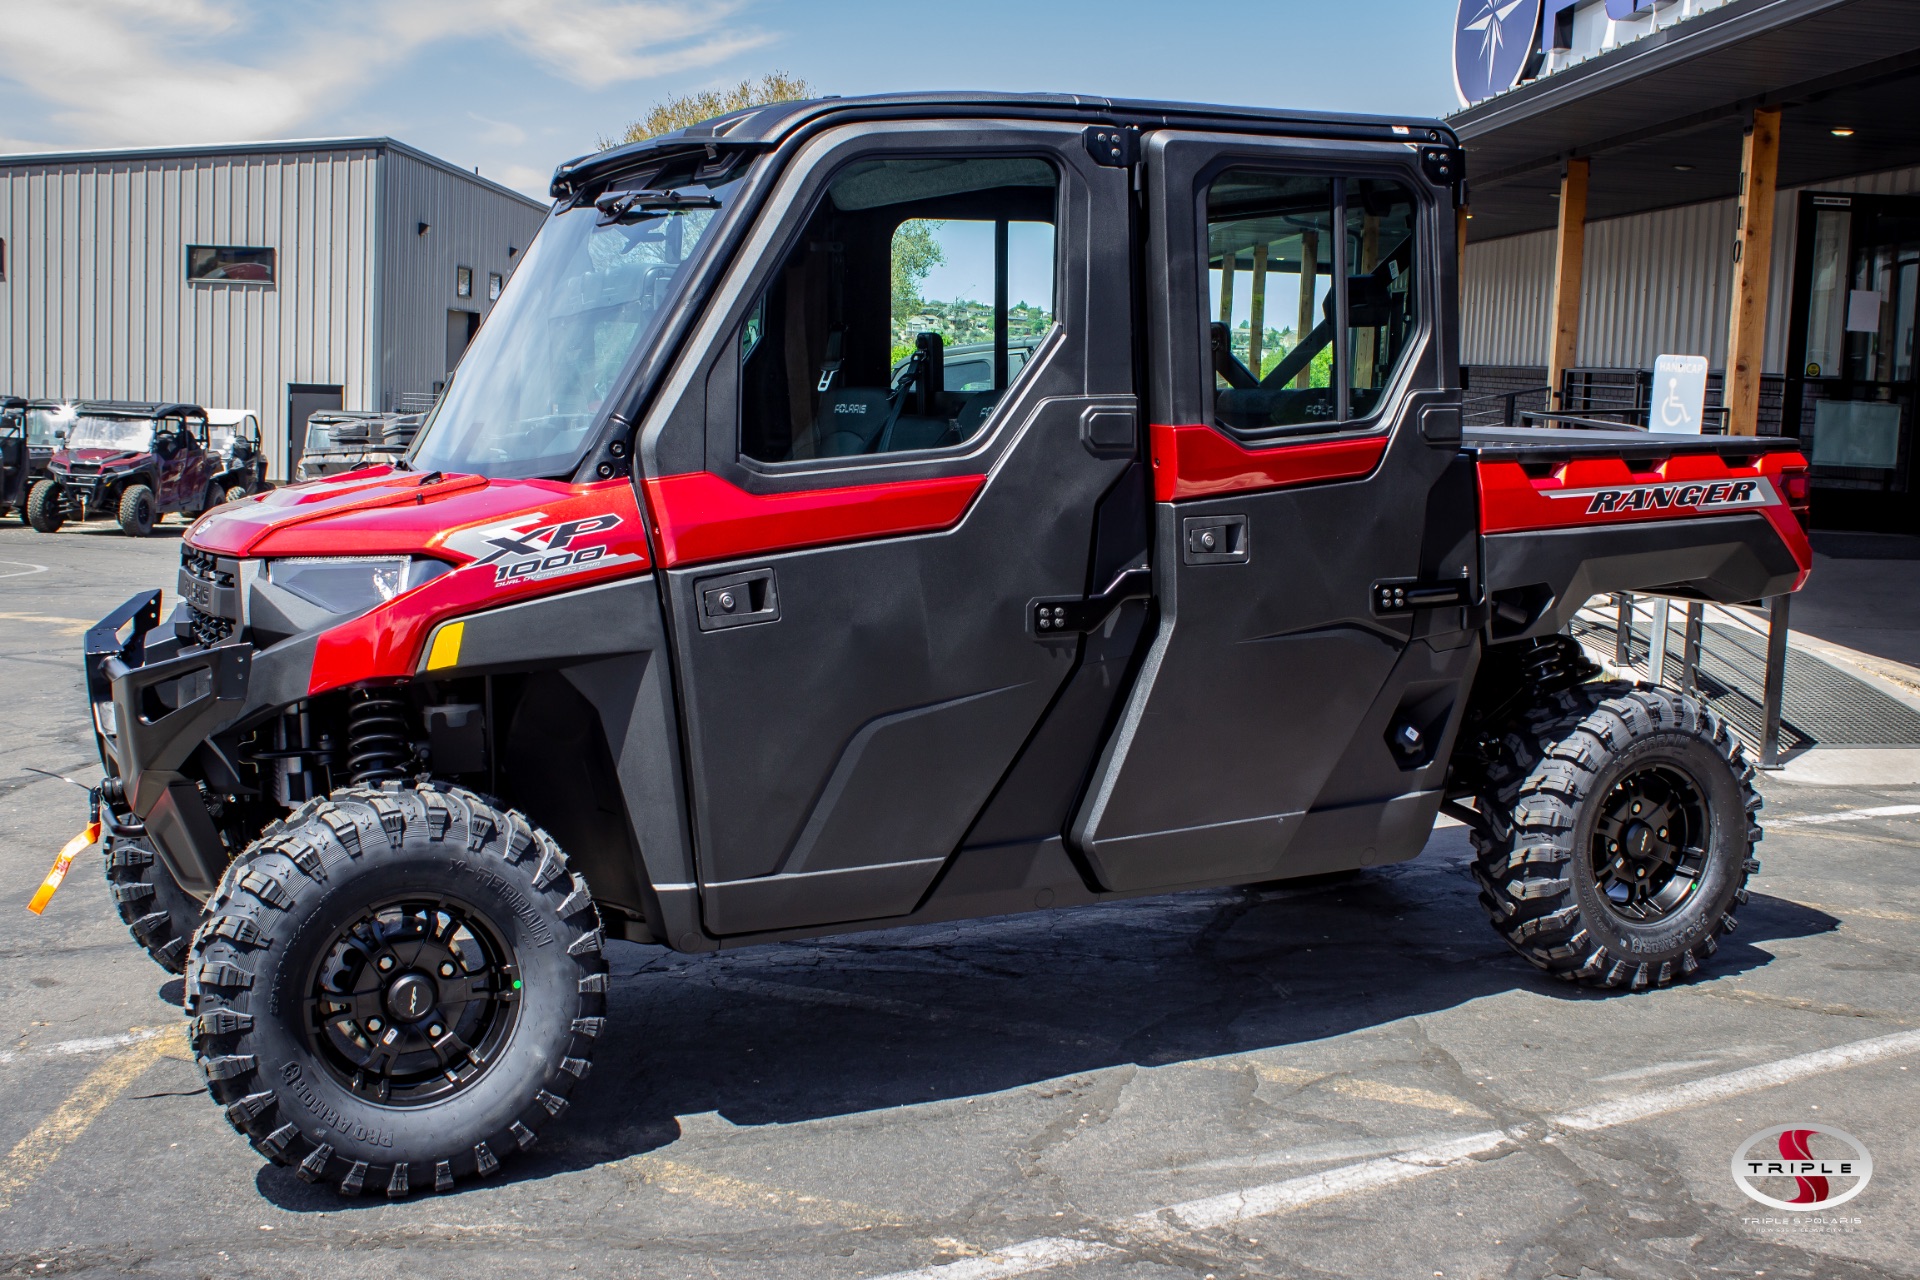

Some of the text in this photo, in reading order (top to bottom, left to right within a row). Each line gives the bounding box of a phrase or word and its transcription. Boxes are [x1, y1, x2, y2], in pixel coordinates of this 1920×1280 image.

[1659, 362, 1703, 374] HANDICAP
[833, 403, 867, 414] POLARIS
[1585, 480, 1757, 515] RANGER
[468, 513, 623, 568] XP
[494, 545, 607, 583] 1000
[494, 561, 601, 588] DUAL OVERHEAD CAM
[448, 858, 554, 949] X-TERRAIN
[291, 1077, 394, 1148] PRO ARMOR
